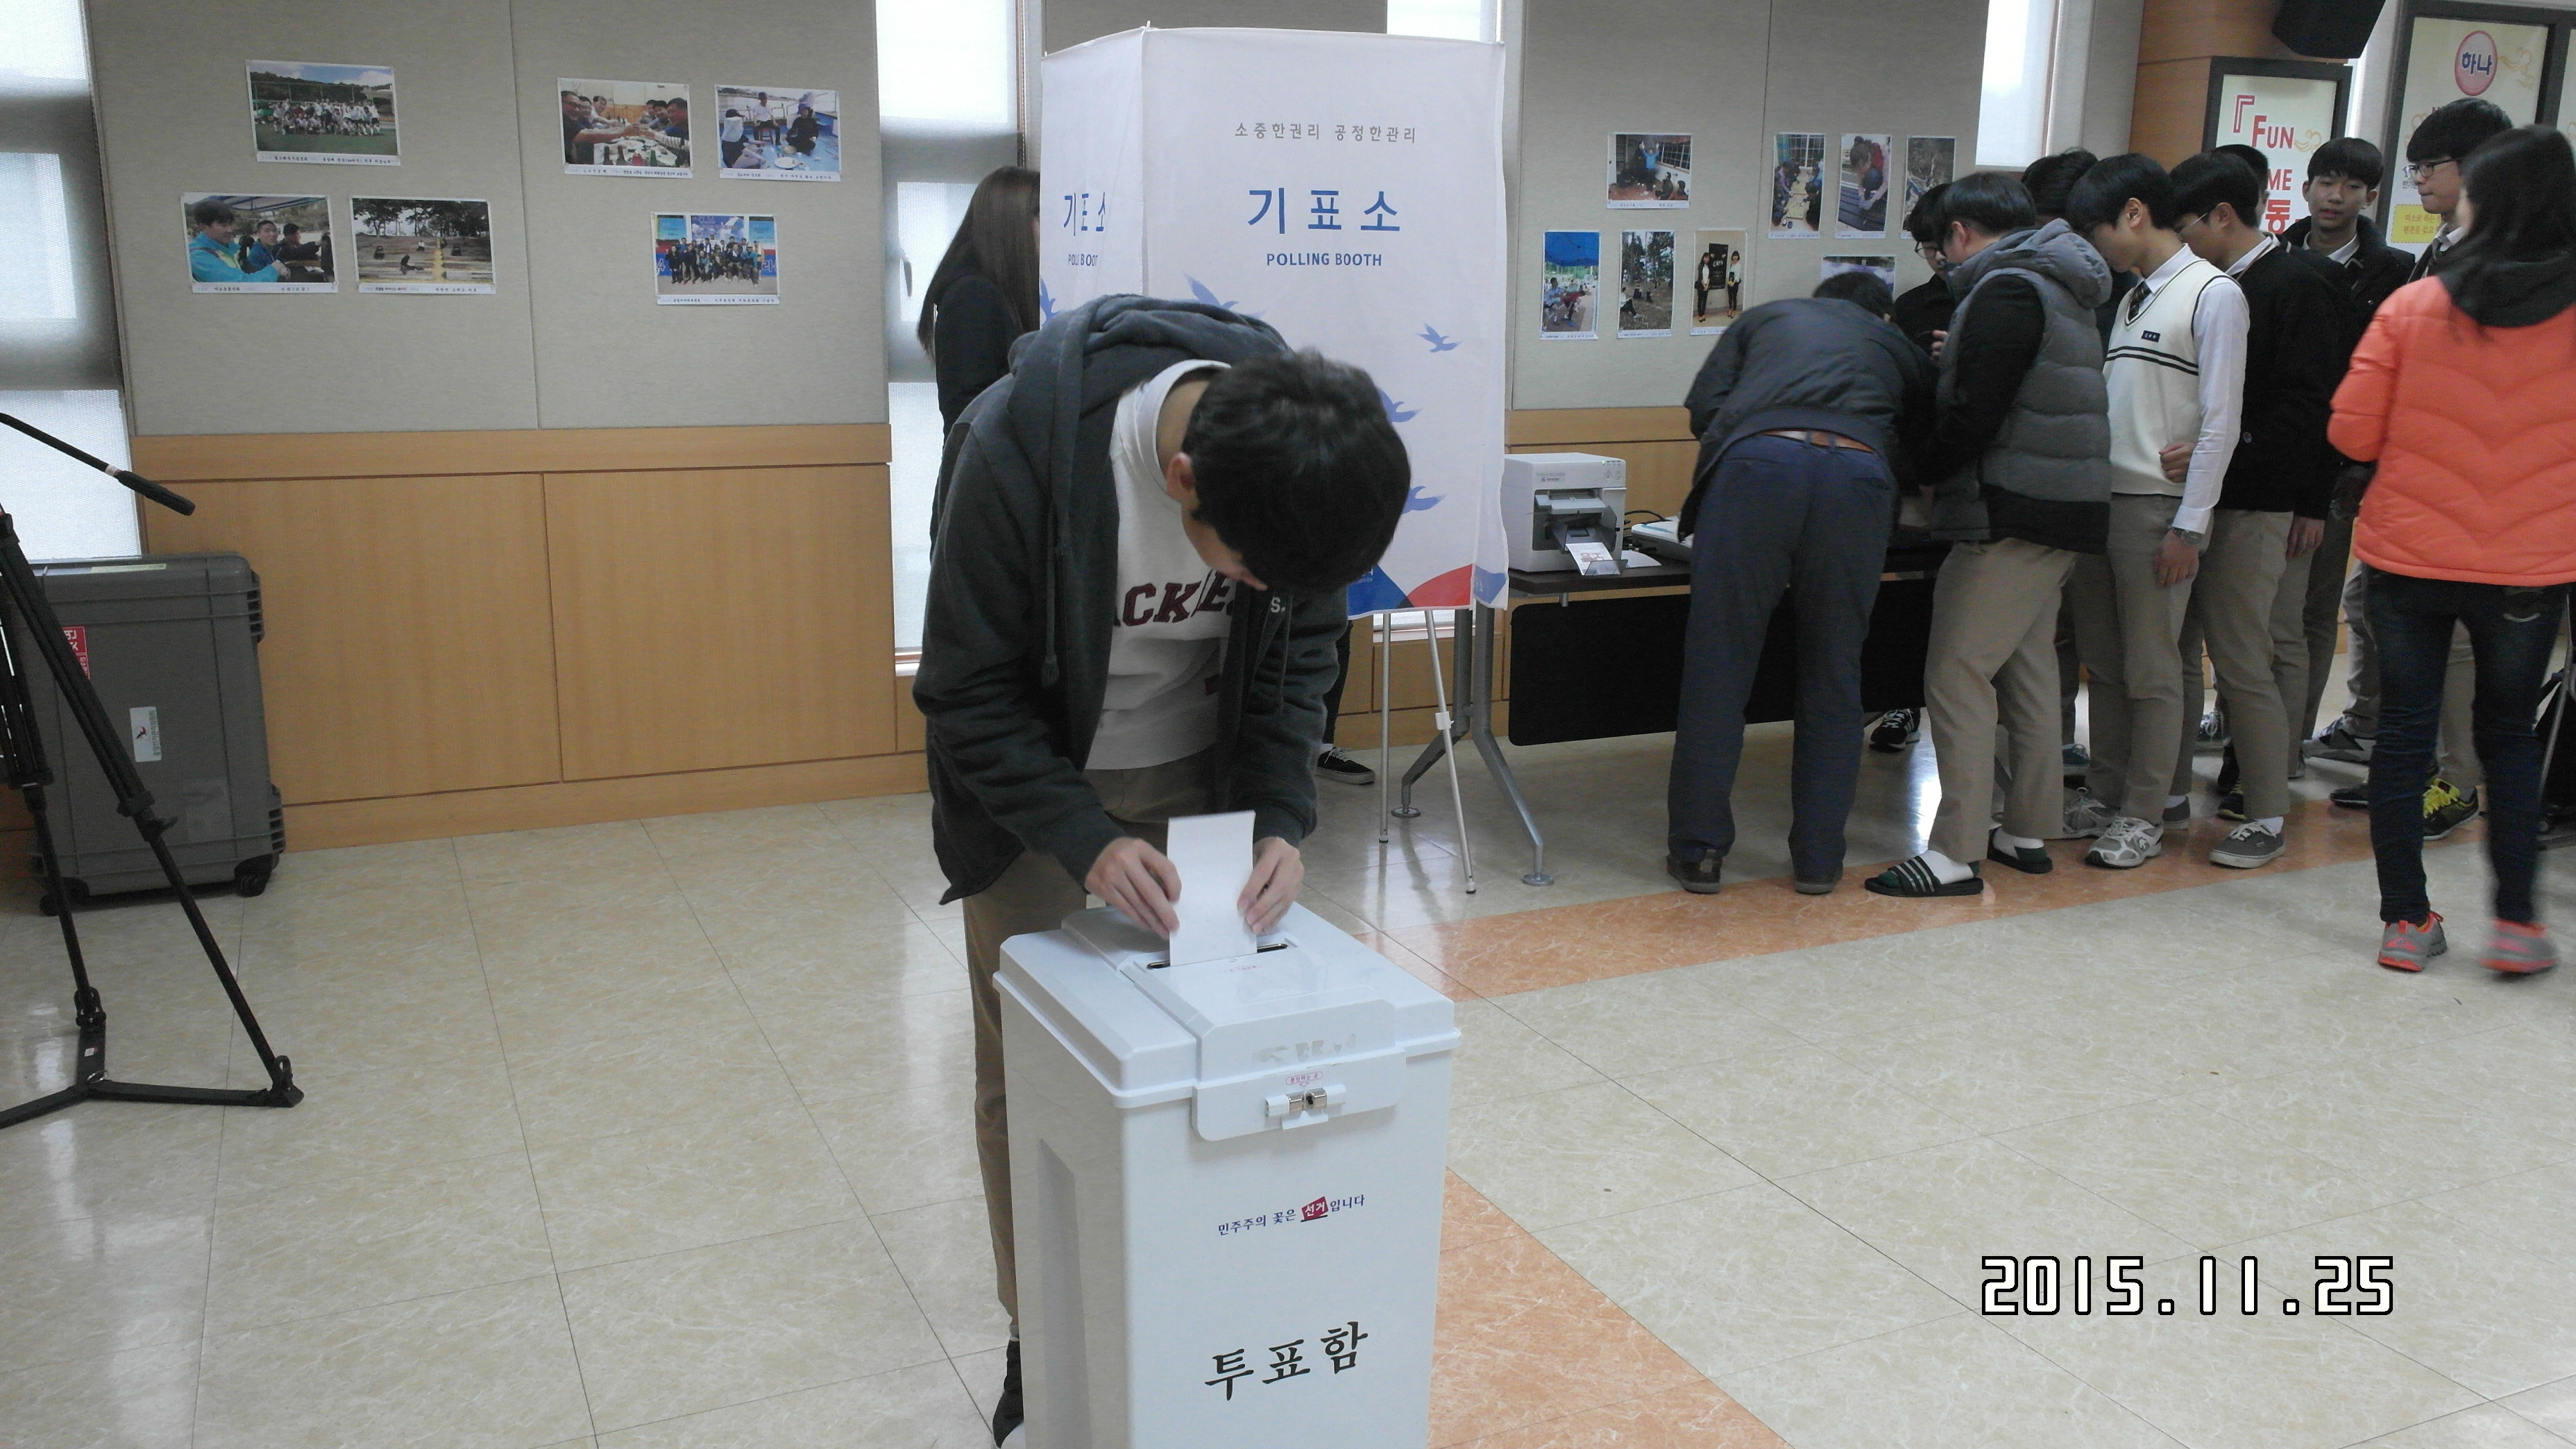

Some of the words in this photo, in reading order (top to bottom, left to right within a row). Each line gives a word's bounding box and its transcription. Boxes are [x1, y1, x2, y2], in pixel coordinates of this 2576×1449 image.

[2461, 52, 2493, 76] 하나
[1235, 122, 1320, 140] 소중한권리
[1334, 124, 1416, 144] 공정한관리
[2266, 169, 2293, 191] ME
[1248, 187, 1400, 235] 기표소
[2265, 199, 2292, 235] 동
[1081, 253, 1099, 266] BOOT
[1266, 253, 1330, 266] POLLING
[1335, 253, 1382, 267] BOOTH
[1115, 572, 1233, 627] CKE
[1218, 1214, 1267, 1236] 민주주의
[1272, 1208, 1297, 1225] 꽃은
[1205, 1321, 1369, 1400] 투표함
